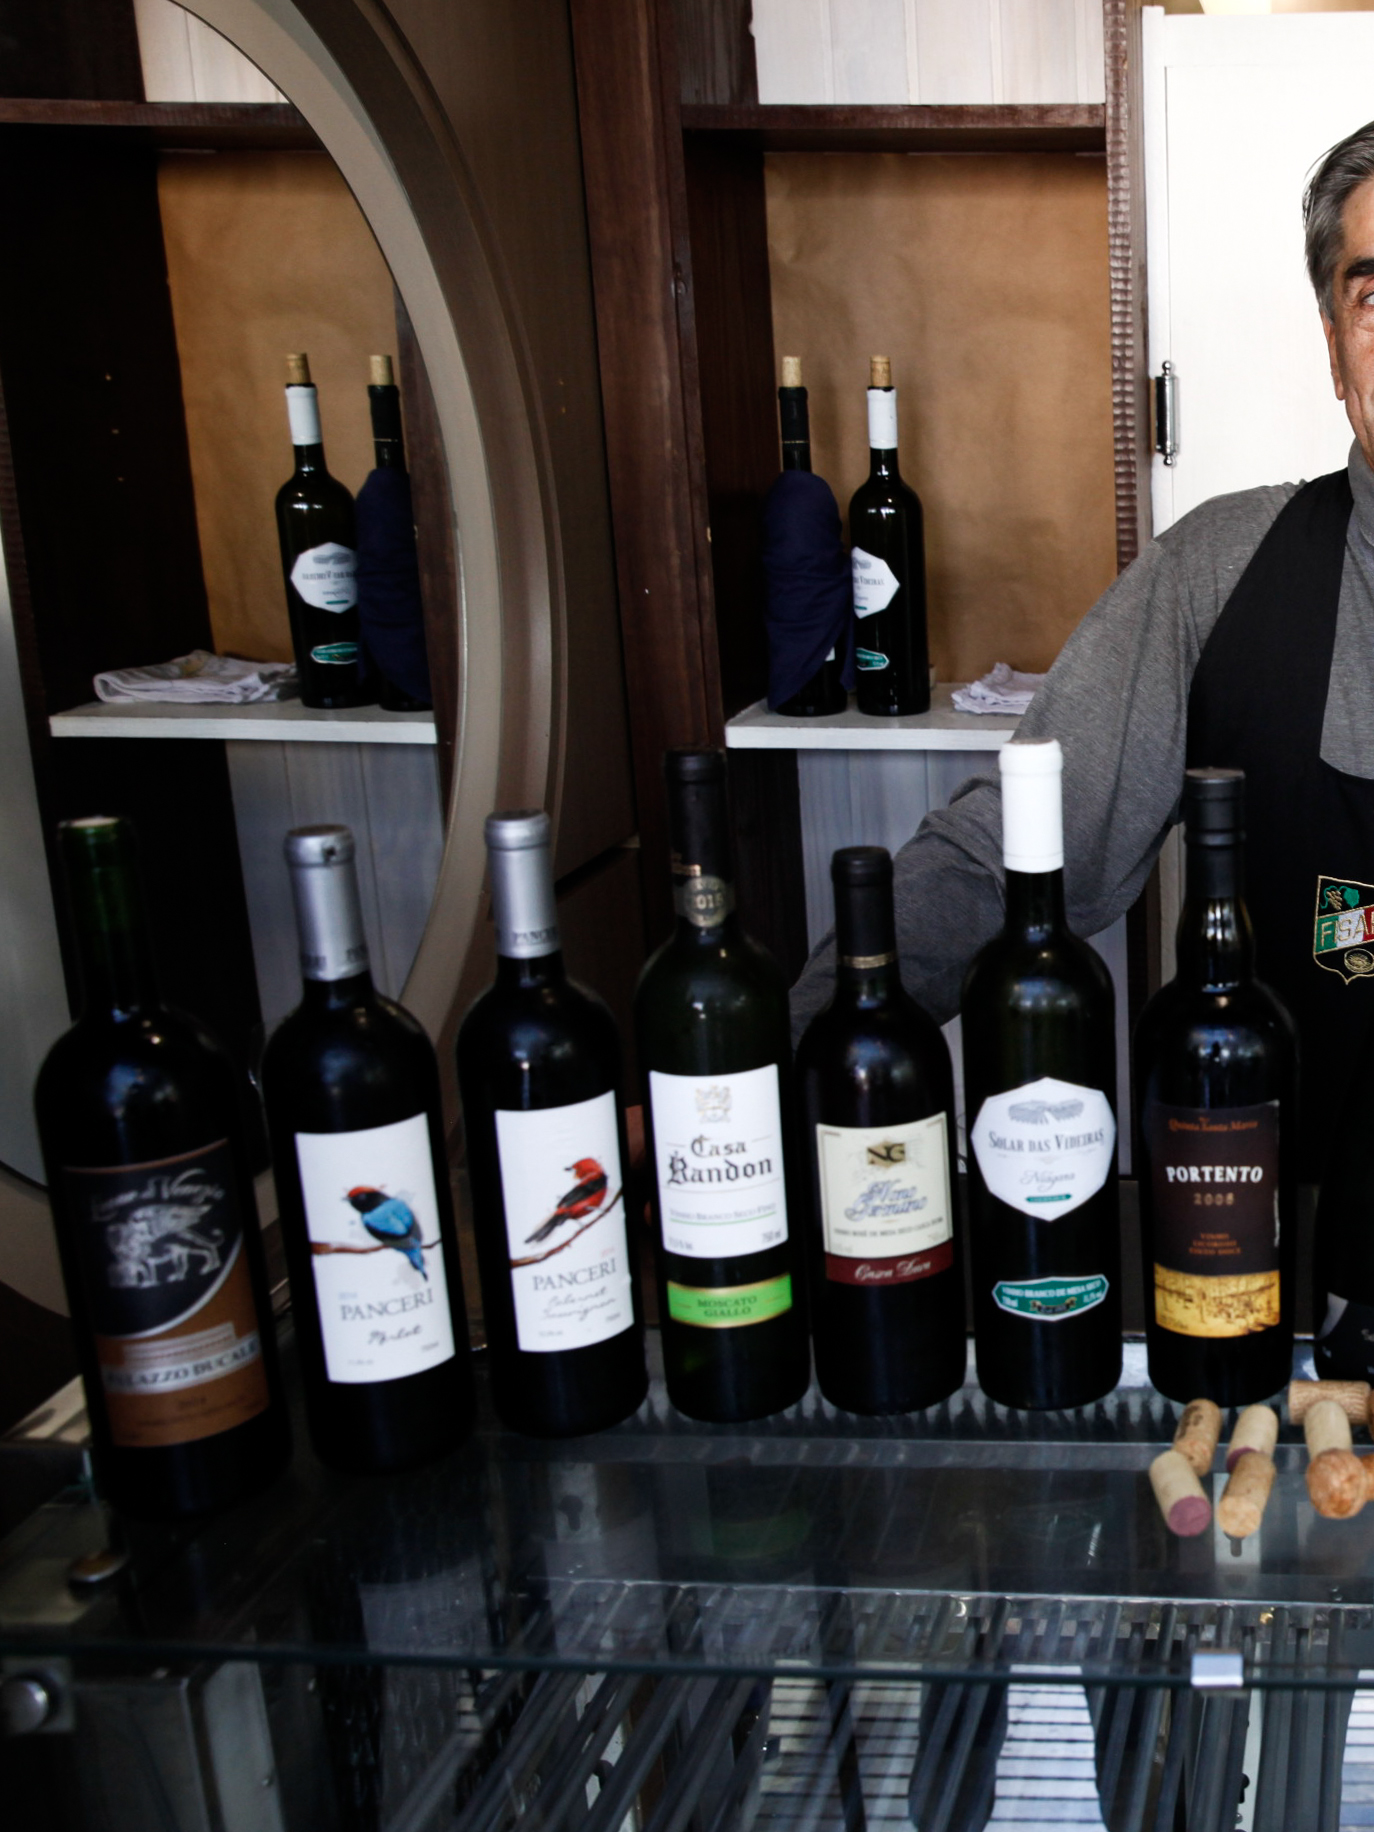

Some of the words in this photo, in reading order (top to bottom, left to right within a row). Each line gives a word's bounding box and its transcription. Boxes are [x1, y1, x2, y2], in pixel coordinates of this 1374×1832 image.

[690, 1134, 747, 1158] Casa
[988, 1130, 1024, 1152] SOLAR
[1029, 1138, 1051, 1152] DAS
[1055, 1127, 1105, 1150] VIDEIRAS
[667, 1150, 773, 1185] Randon
[1165, 1165, 1263, 1183] PORTENTO
[532, 1257, 617, 1291] PANCERI
[340, 1287, 434, 1321] PANCERI
[697, 1295, 758, 1308] MOSCATO
[703, 1307, 752, 1317] GIALLO
